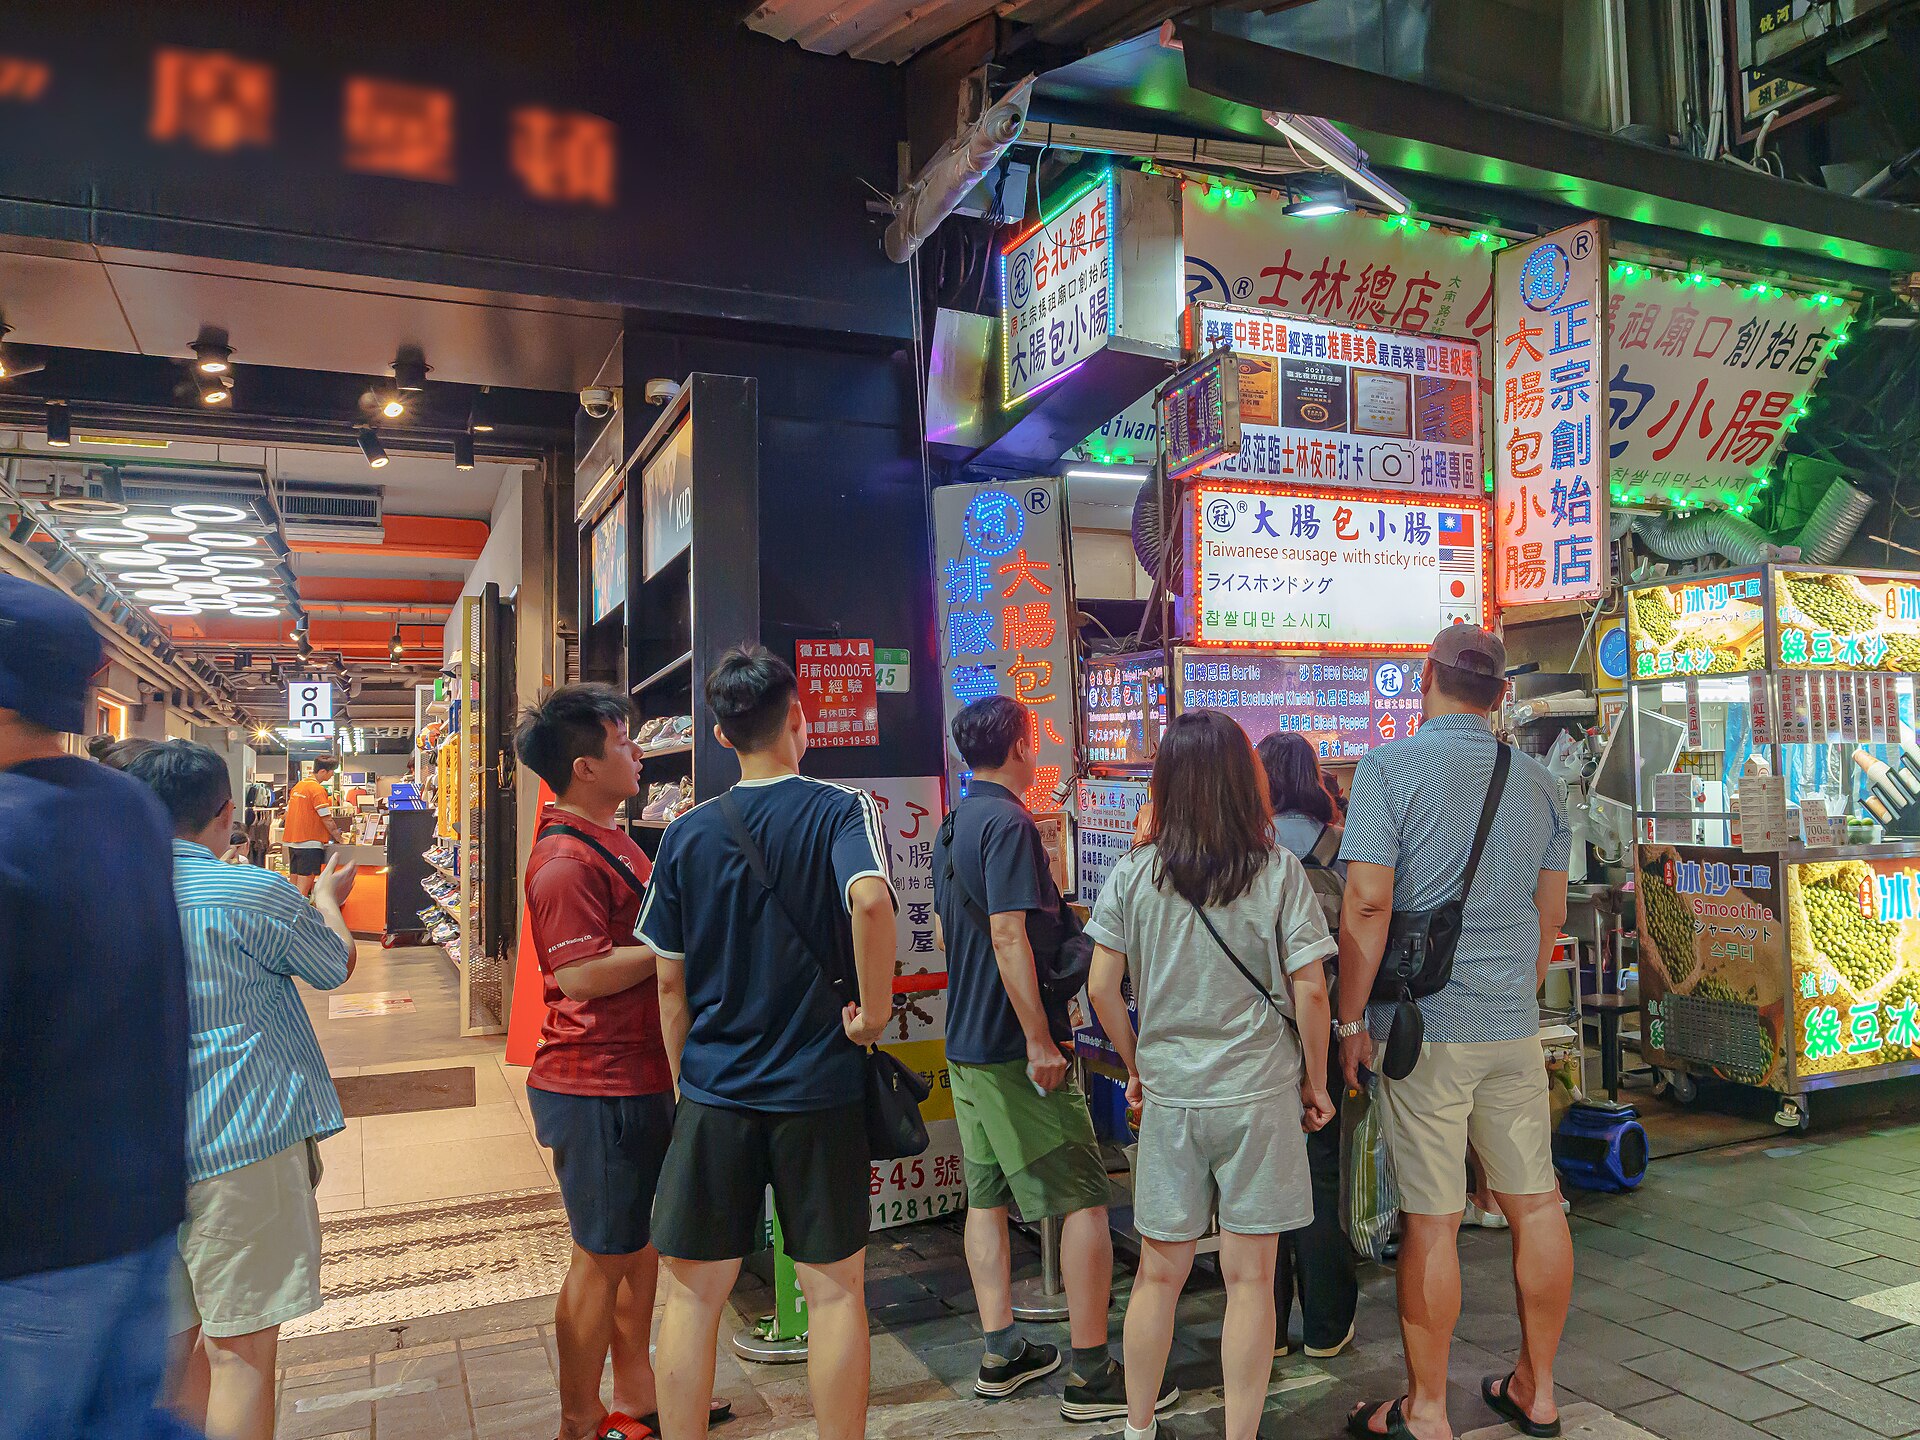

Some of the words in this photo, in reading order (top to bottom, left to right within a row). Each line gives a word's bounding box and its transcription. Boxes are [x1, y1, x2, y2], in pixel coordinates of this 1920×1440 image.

[1033, 198, 1108, 291] 台北總店
[1258, 248, 1442, 332] 士林總店
[1011, 286, 1108, 388] 大腸包小腸
[1503, 316, 1547, 591] 大腸包小腸
[1549, 299, 1594, 587] 正宗創始店
[1421, 448, 1475, 490] 拍照專區
[1251, 500, 1432, 546] 大腸包小腸
[1205, 540, 1279, 559] Taiwanese
[1282, 547, 1338, 566] sausage
[1343, 549, 1371, 564] with
[1374, 550, 1410, 570] sticky
[1413, 551, 1436, 567] rice
[1684, 578, 1762, 614] 冰沙工廠
[1637, 646, 1716, 677] 綠豆冰沙
[1781, 628, 1888, 666] 綠豆冰沙
[876, 668, 896, 686] 45
[1232, 665, 1261, 681] Garlic
[1299, 664, 1323, 682] 沙茶
[1342, 665, 1369, 682] Satay
[1241, 690, 1285, 706] Exclusive
[1286, 691, 1315, 707] Kimchi
[1316, 689, 1348, 706] 九層塔
[1349, 690, 1371, 706] Basil
[1280, 714, 1312, 732] 黑胡椒
[1314, 715, 1338, 731] Black
[1339, 715, 1370, 731] Pepper
[1319, 740, 1341, 757] 蜜汁
[1343, 741, 1369, 756] Honey
[1674, 860, 1772, 897] 冰沙工廠
[1693, 898, 1774, 922] Smoothie
[1693, 921, 1773, 944] シャーベット
[1710, 942, 1755, 962] 스무디
[1800, 972, 1838, 999] 植物
